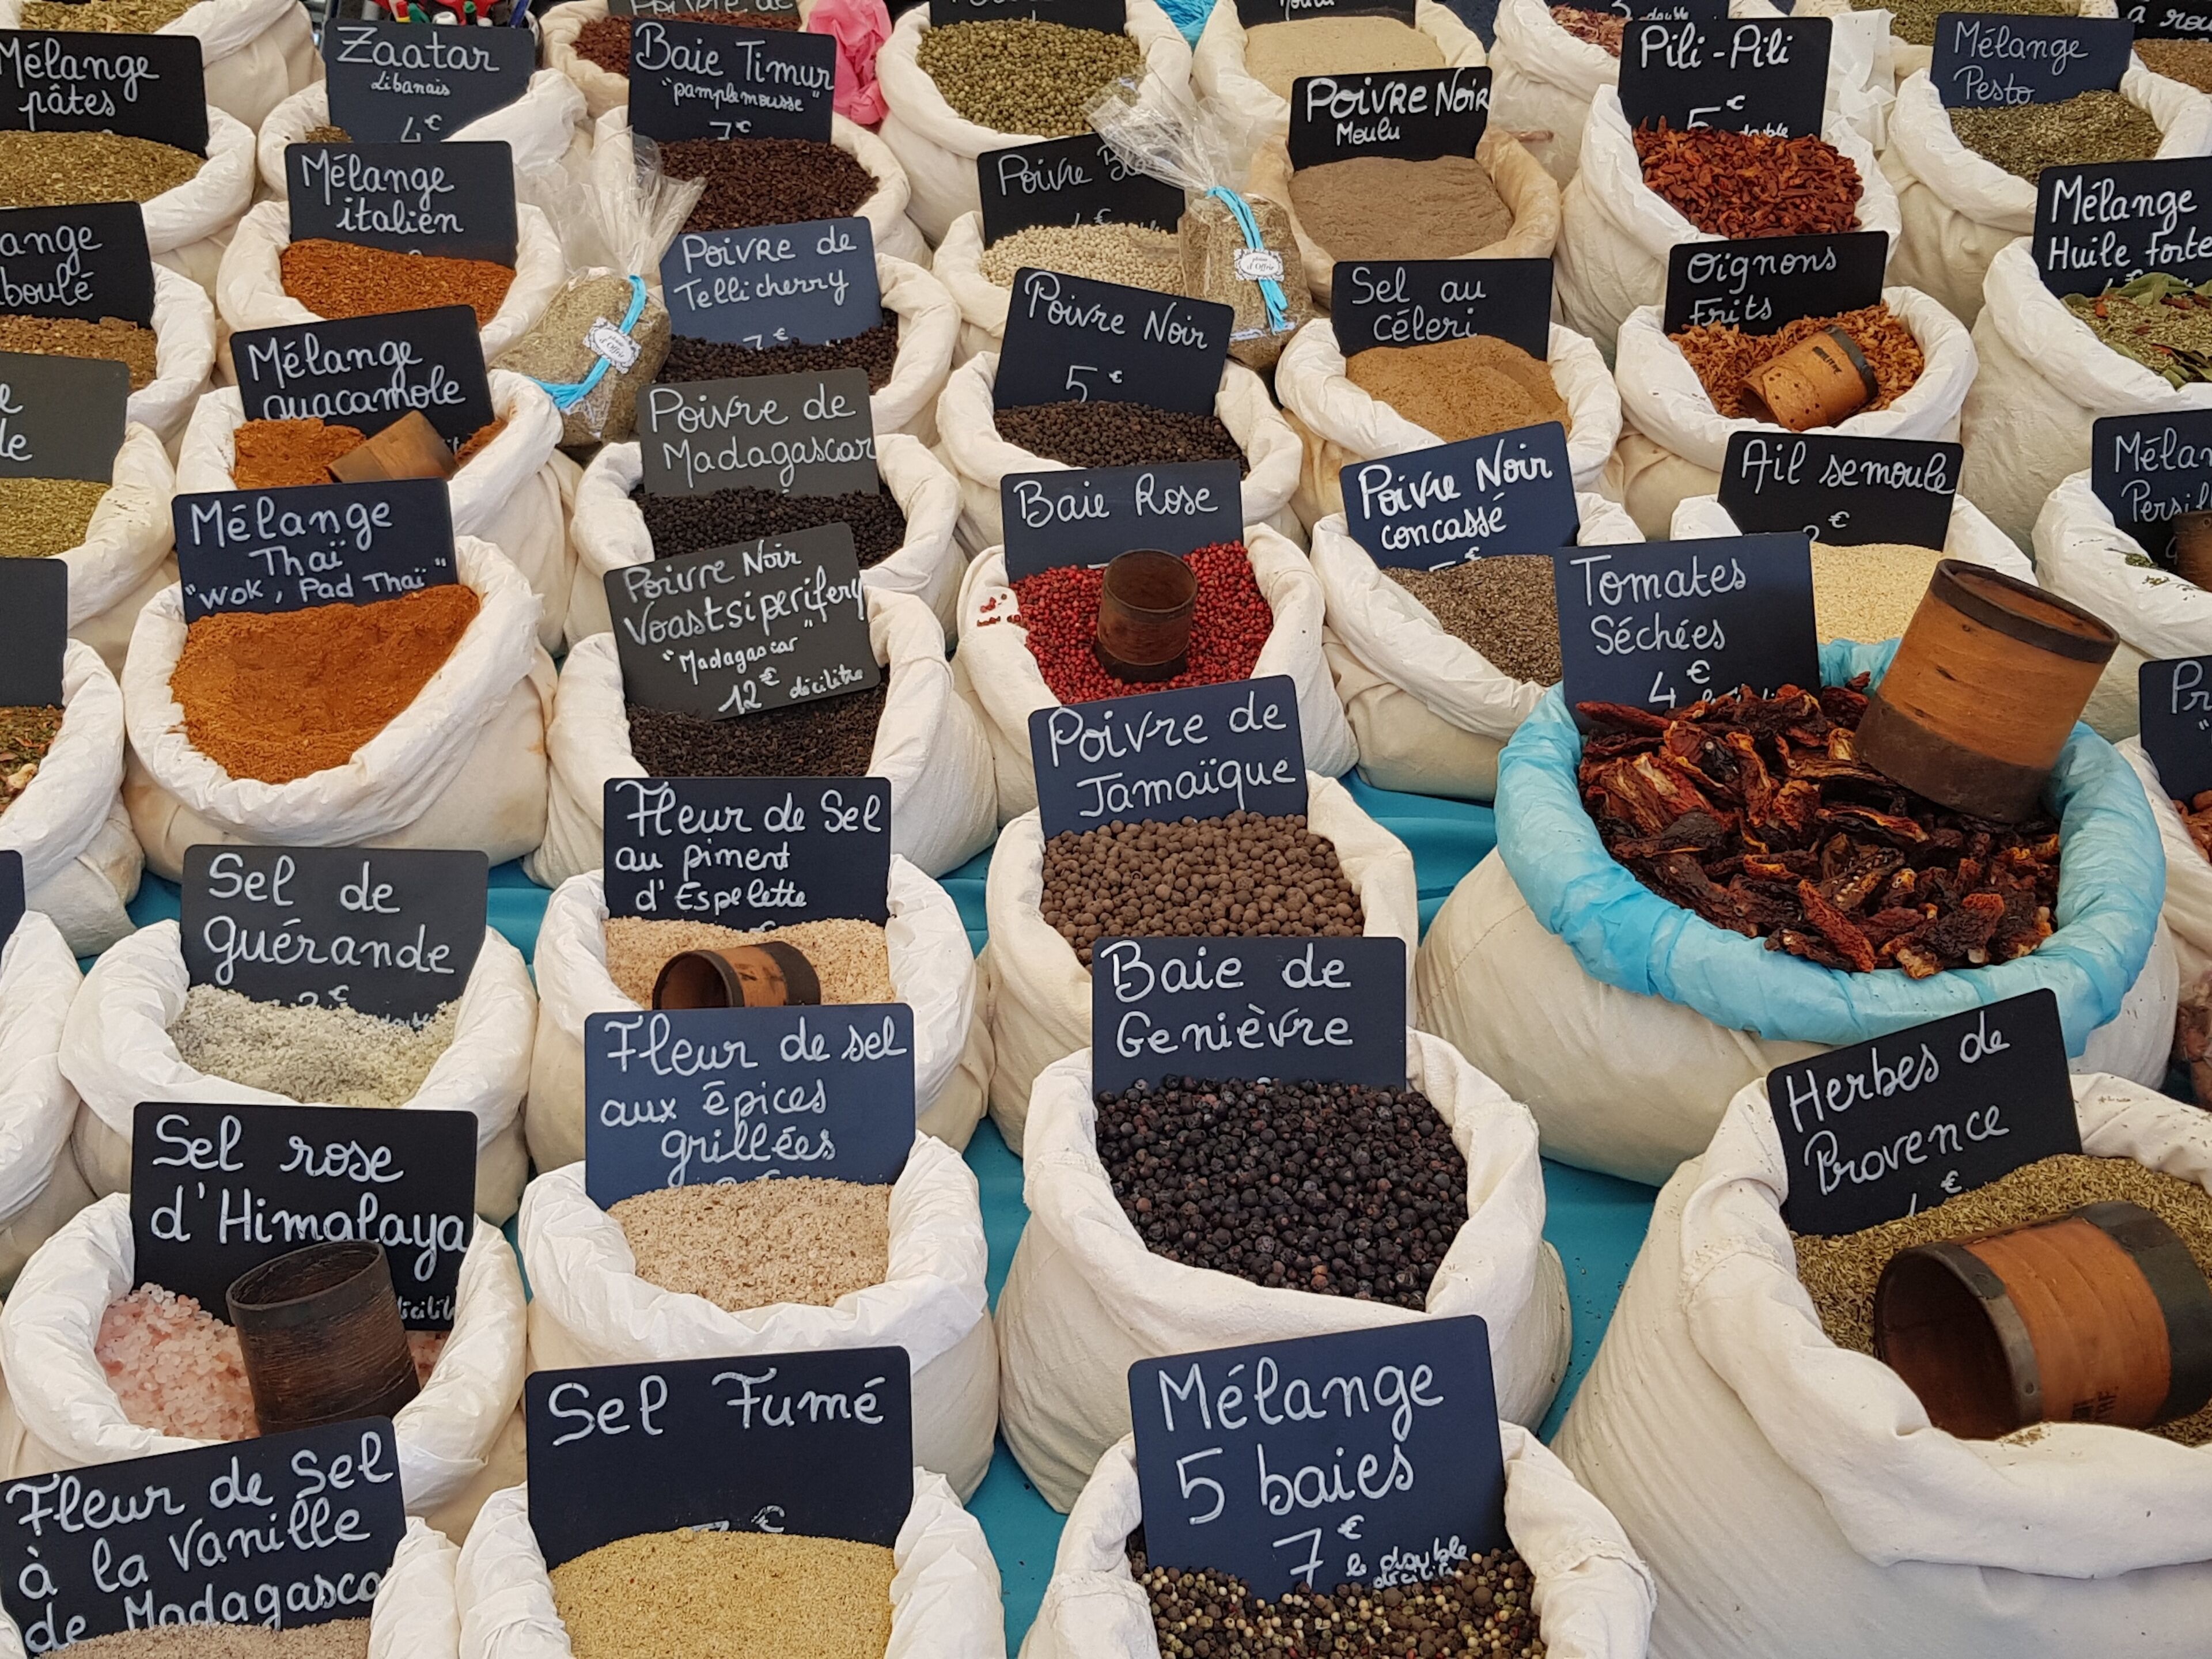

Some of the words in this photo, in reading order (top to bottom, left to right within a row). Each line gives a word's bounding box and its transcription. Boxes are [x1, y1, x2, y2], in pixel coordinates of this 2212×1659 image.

[0, 36, 160, 101] Mélange
[337, 26, 499, 73] Zaatar
[635, 21, 724, 77] Baie
[736, 40, 834, 91] Timur
[1954, 21, 2089, 75] Mélange
[18, 83, 116, 131] pâtes
[371, 73, 450, 97] Libanais
[1953, 65, 2035, 105] Pesto
[1336, 116, 1400, 146] Moulu
[301, 149, 454, 206] Mélange
[998, 154, 1093, 196] Poivre
[338, 196, 464, 234] italien
[2052, 175, 2197, 232] Mélange
[816, 225, 857, 257] de
[2048, 231, 2131, 271] Huile
[2145, 226, 2212, 266] Forte
[0, 266, 94, 306] boulé
[674, 268, 850, 311] Tellicherry
[1351, 266, 1411, 305] Sel
[1440, 280, 1487, 303] au
[1687, 247, 1836, 294] Oignons
[1024, 271, 1126, 335] Poivre
[1143, 302, 1207, 350] Noir
[1689, 297, 1772, 326] Frits
[248, 332, 423, 389] Mélange
[649, 387, 790, 434] Poivre
[802, 382, 856, 419] de
[663, 435, 876, 488] Madagascar
[1357, 464, 1461, 520] Poivre
[1475, 438, 1553, 493] Noir
[1741, 439, 1806, 494] Ail
[1819, 453, 1955, 494] semoule
[190, 496, 393, 551] Mélange
[1013, 480, 1111, 528] Baie
[1134, 472, 1218, 516] Rose
[1381, 493, 1507, 550] concassé
[2121, 479, 2212, 522] Persil
[249, 540, 346, 577] Thaï
[624, 559, 734, 603] Poivre
[743, 540, 802, 577] Noir
[1570, 555, 1747, 607] Tomates
[298, 575, 354, 603] Pad
[1590, 612, 1726, 656] Séchées
[1048, 706, 1209, 767] Poivre
[1229, 690, 1286, 732] de
[615, 780, 752, 837] Fleur
[764, 793, 806, 832] de
[820, 789, 881, 832] Sel
[1076, 757, 1296, 817] Jamaïque
[207, 853, 296, 907] Sel
[339, 861, 401, 914] de
[615, 847, 663, 872] au
[683, 838, 791, 881] piment
[1100, 940, 1244, 1002] Baie
[1282, 943, 1351, 988] de
[604, 1013, 758, 1076] Fleur
[780, 1016, 830, 1062] de
[841, 1015, 907, 1062] sel
[1116, 1003, 1353, 1058] Genièvre
[1786, 1043, 1940, 1133] Herbes
[1959, 1010, 2011, 1063] de
[600, 1097, 676, 1127] aux
[703, 1079, 827, 1129] épices
[153, 1114, 244, 1171] Sel
[279, 1135, 404, 1183] rose
[661, 1119, 836, 1188] grillées
[1804, 1105, 2010, 1195] Provence
[548, 1374, 668, 1446] Sel
[711, 1367, 886, 1429] Fumé
[1158, 1357, 1444, 1442] Mélange
[6, 1473, 185, 1537] Fleur
[209, 1456, 274, 1509] de
[290, 1431, 393, 1499] Sel
[1176, 1447, 1226, 1525] 5
[1256, 1443, 1414, 1516] baies
[17, 1547, 58, 1601] à
[92, 1537, 150, 1594] la
[169, 1497, 371, 1573] Vanille
[1346, 1553, 1367, 1577] le
[1380, 1535, 1469, 1571] double
[24, 1601, 88, 1653] de
[123, 1571, 381, 1631] Madagasca
